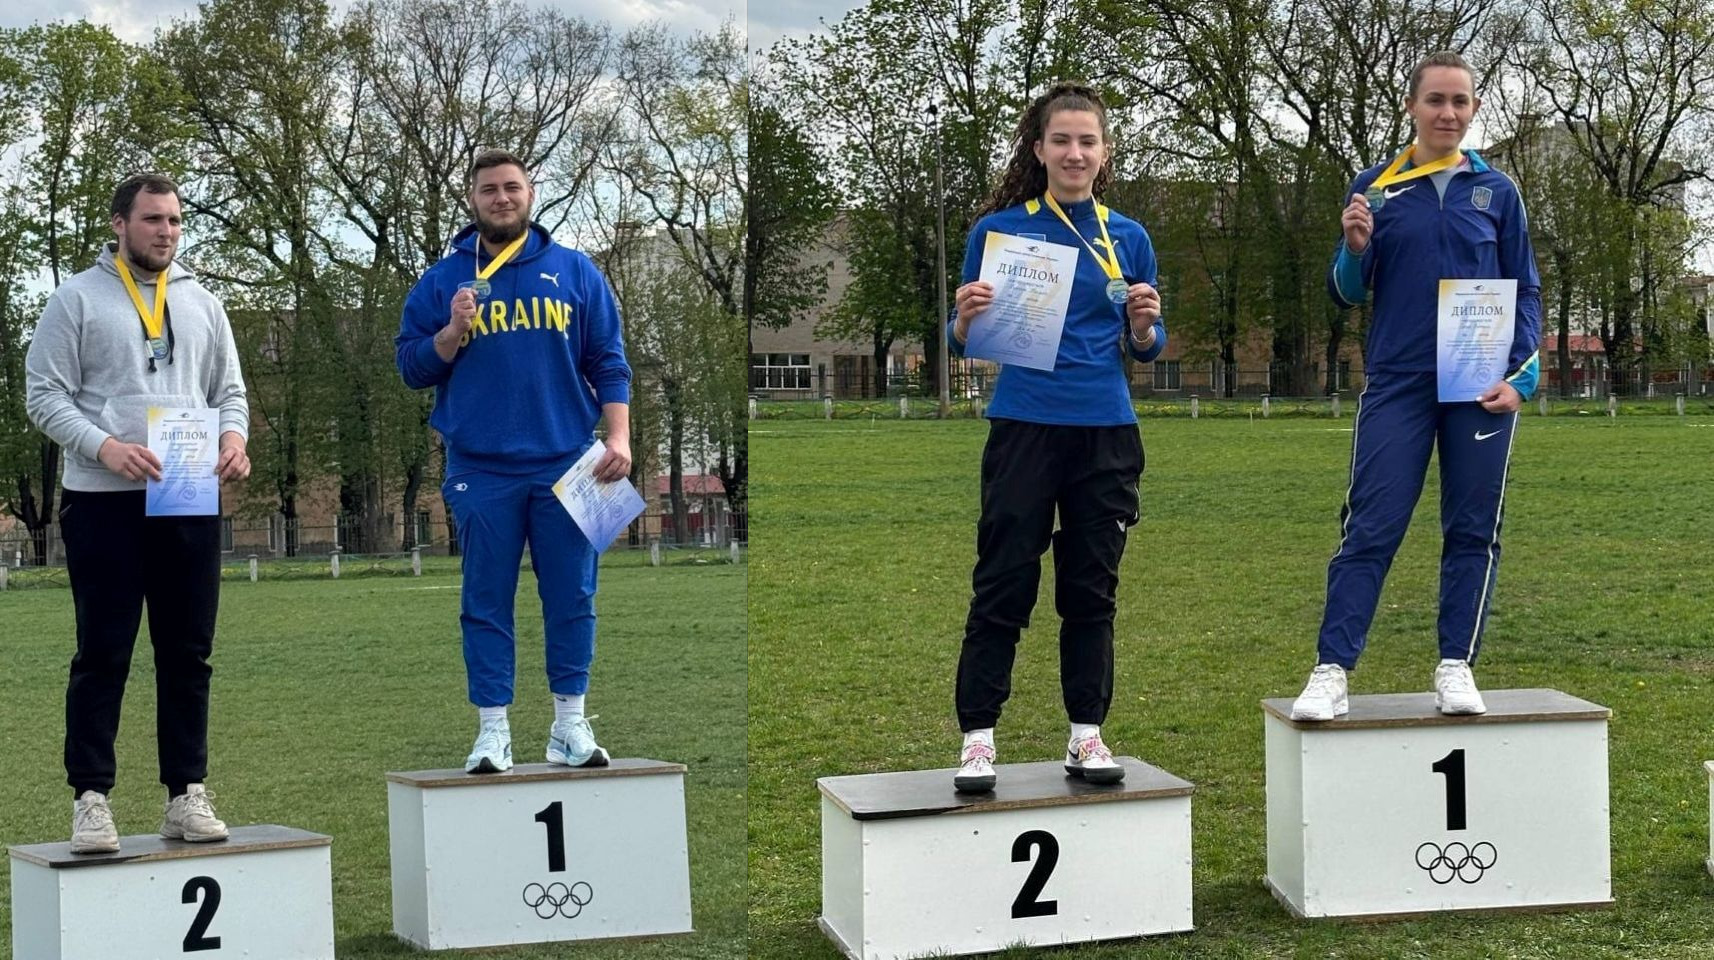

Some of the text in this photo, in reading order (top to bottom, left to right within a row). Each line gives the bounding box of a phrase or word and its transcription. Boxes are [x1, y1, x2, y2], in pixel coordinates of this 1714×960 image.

[996, 262, 1060, 284] ДИПЛОМ
[459, 297, 573, 347] KRAINE
[1451, 305, 1504, 317] ДИПЛОМ
[160, 431, 208, 441] ДИПЛОМ
[571, 473, 595, 500] ДИПЛ
[1433, 749, 1466, 830] 1
[535, 802, 565, 872] 1
[1012, 830, 1059, 918] 2
[182, 876, 221, 952] 2
